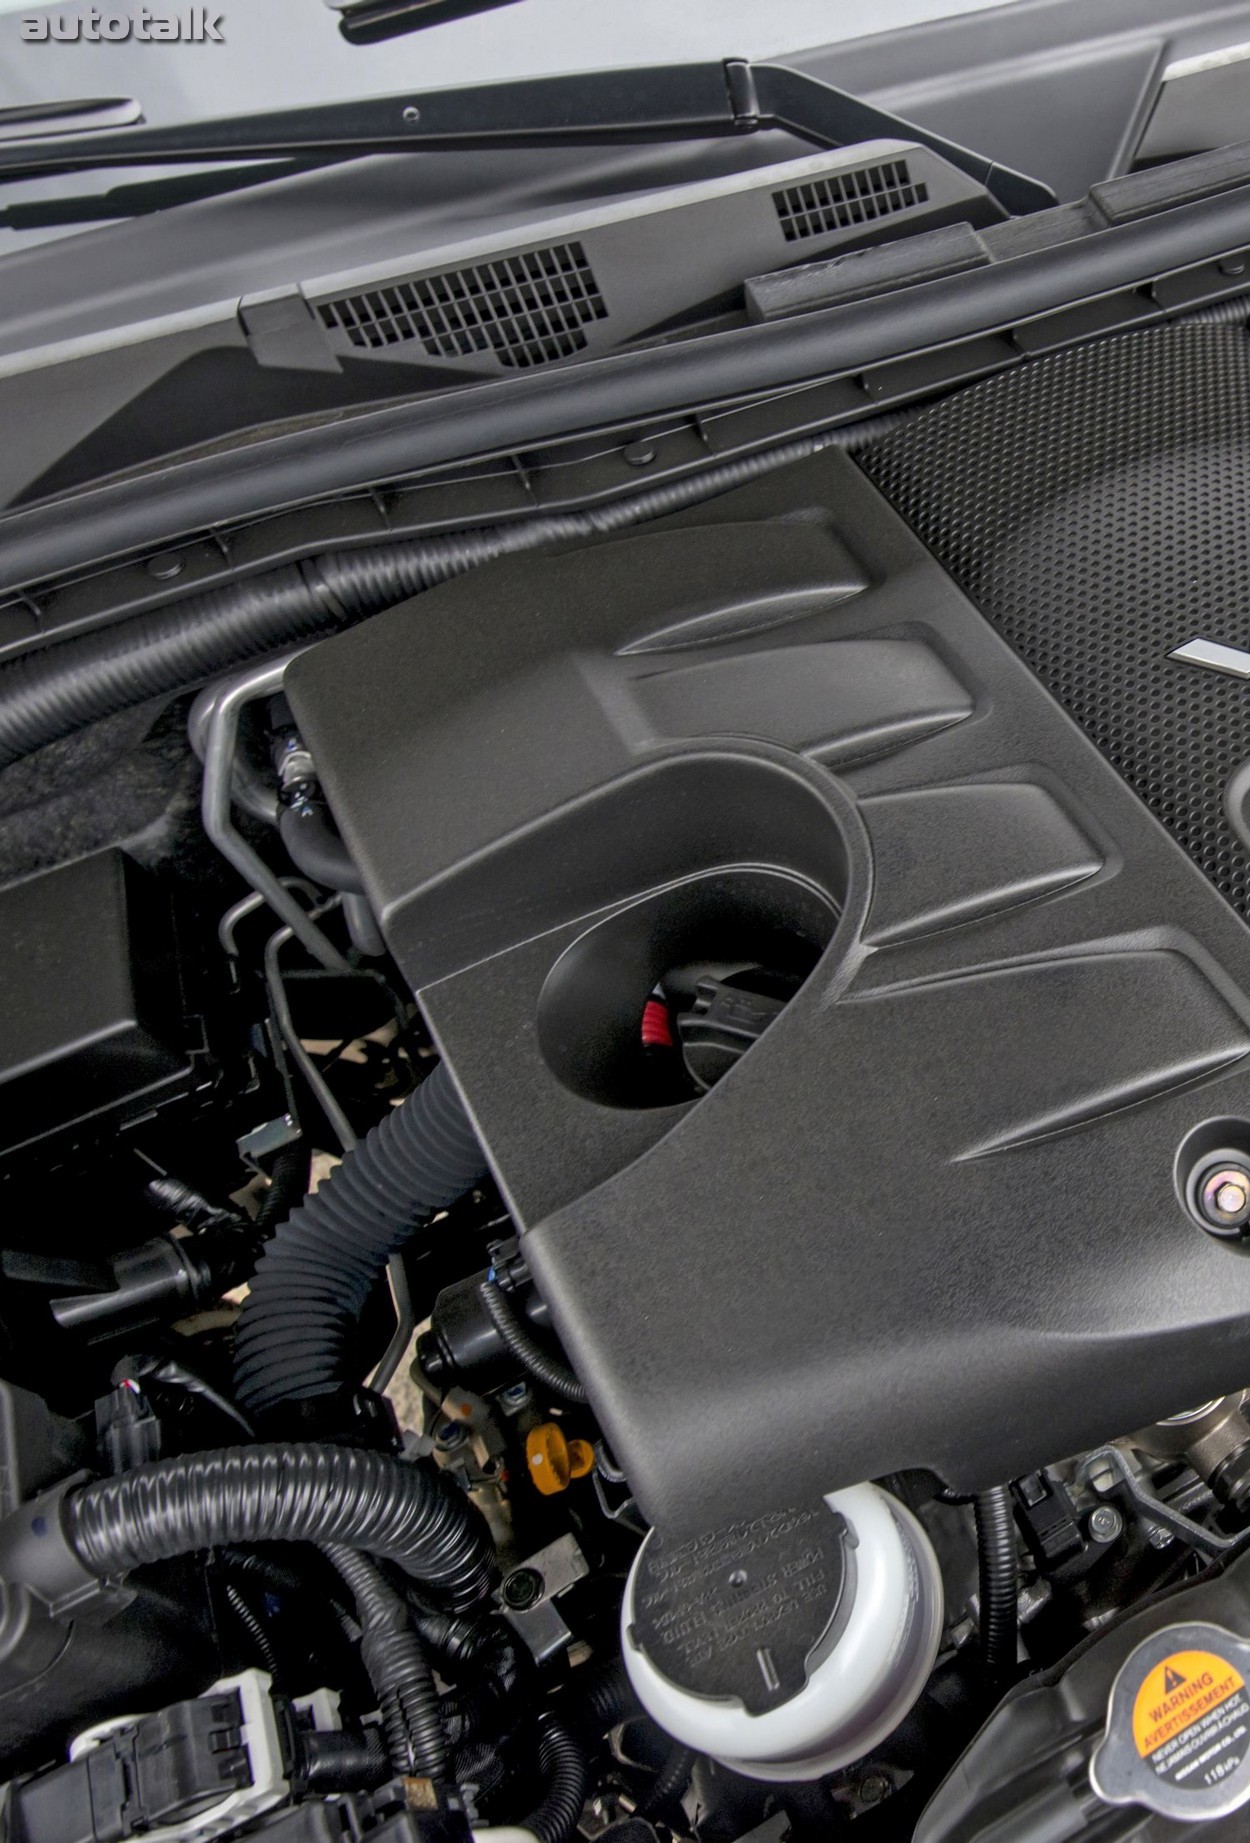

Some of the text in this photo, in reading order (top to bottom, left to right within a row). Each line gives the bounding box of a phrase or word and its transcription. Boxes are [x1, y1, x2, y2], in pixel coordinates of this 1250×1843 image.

[781, 1547, 825, 1578] POWER
[794, 1568, 826, 1591] FILL
[1143, 1676, 1236, 1749] AVERTISSEMENT
[1148, 1671, 1214, 1723] WARNING
[1151, 1739, 1179, 1763] NEVER
[1178, 1724, 1202, 1746] OPEN
[1200, 1707, 1225, 1729] WHEN
